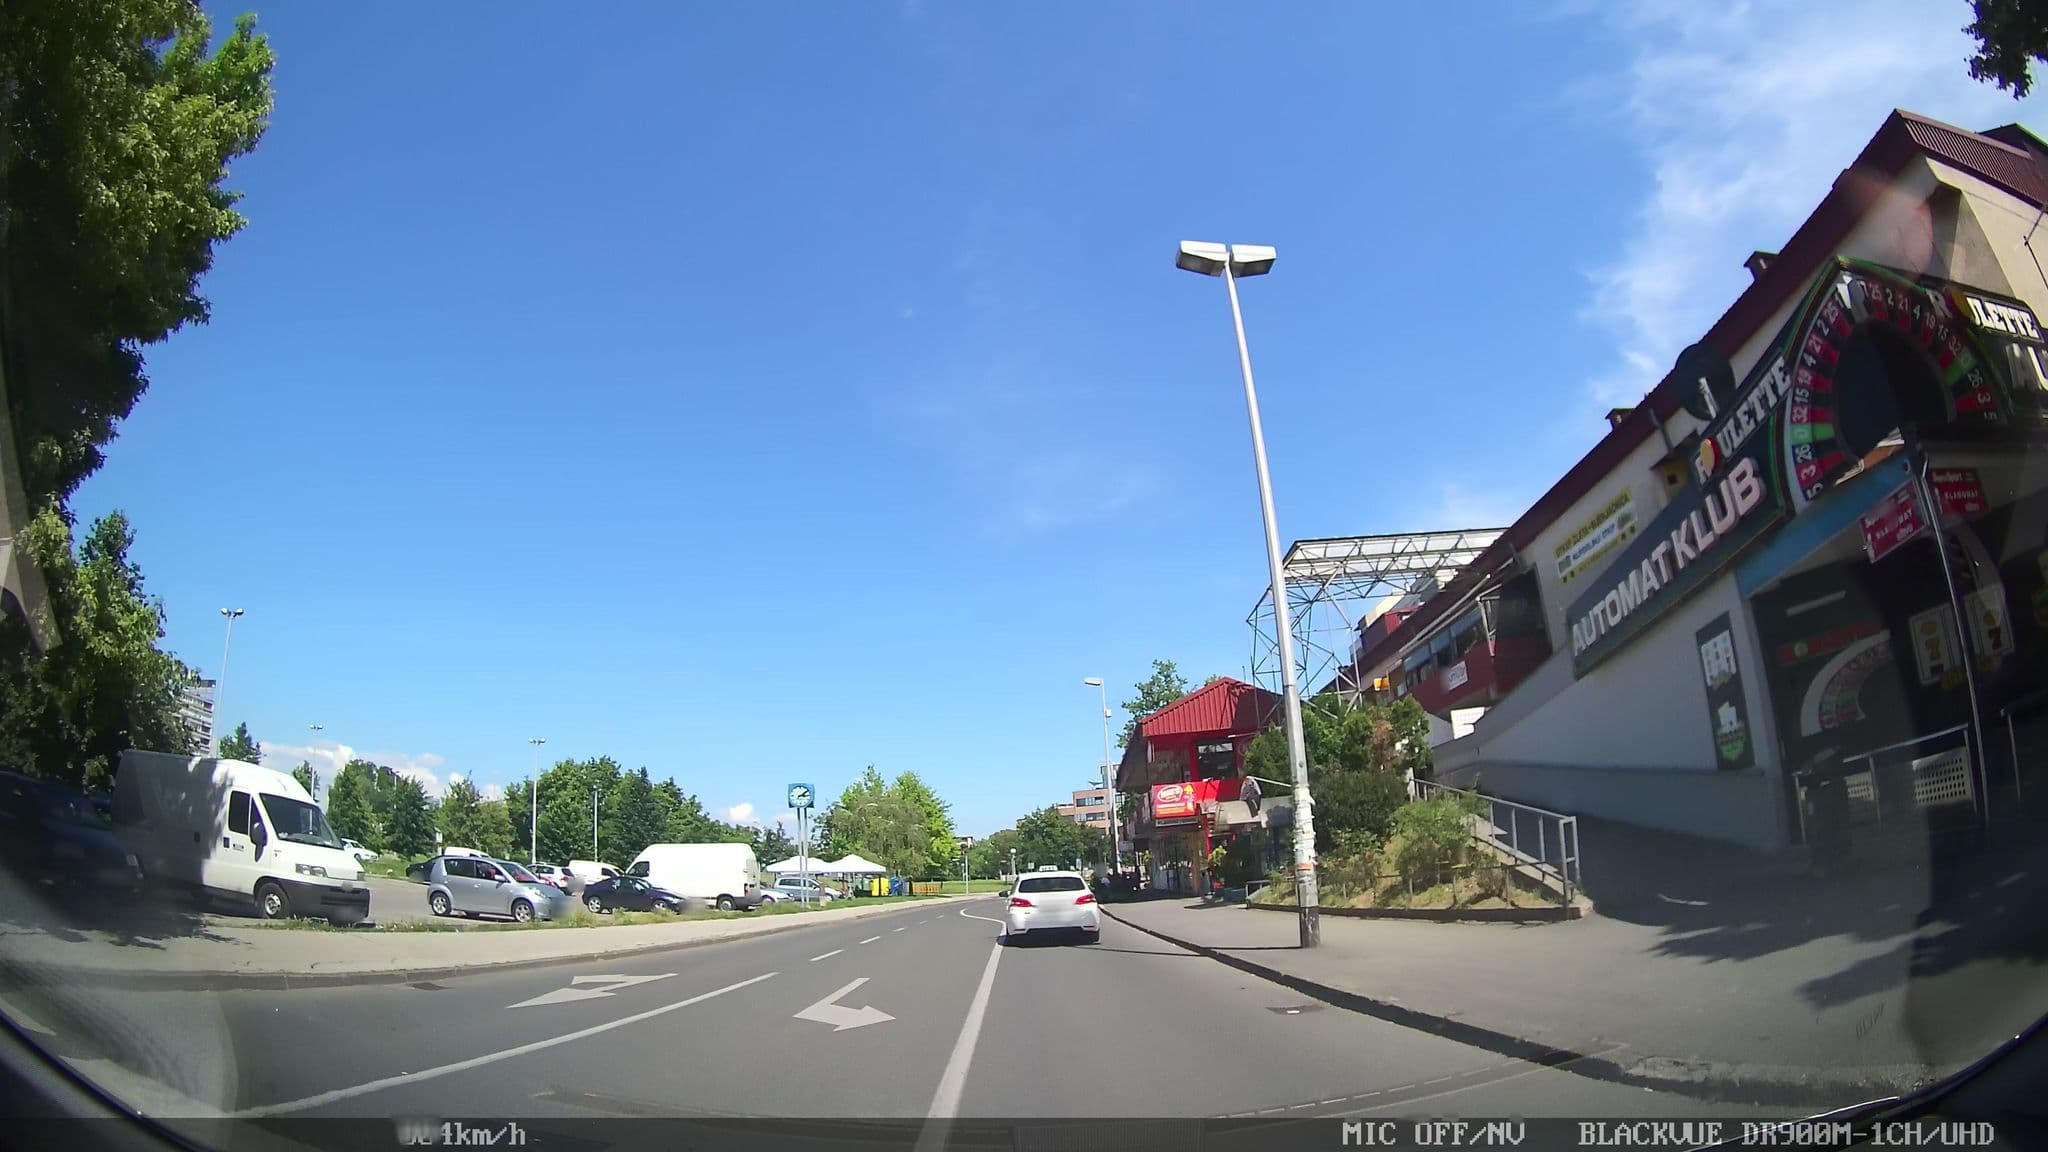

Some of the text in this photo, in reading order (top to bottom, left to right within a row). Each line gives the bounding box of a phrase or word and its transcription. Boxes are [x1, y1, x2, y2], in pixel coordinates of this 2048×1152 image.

[1885, 287, 1895, 307] 2
[1816, 319, 1830, 336] 2
[1801, 463, 1817, 480] 3
[1571, 539, 1675, 657] AUTOMAT
[1670, 456, 1767, 570] KLUB
